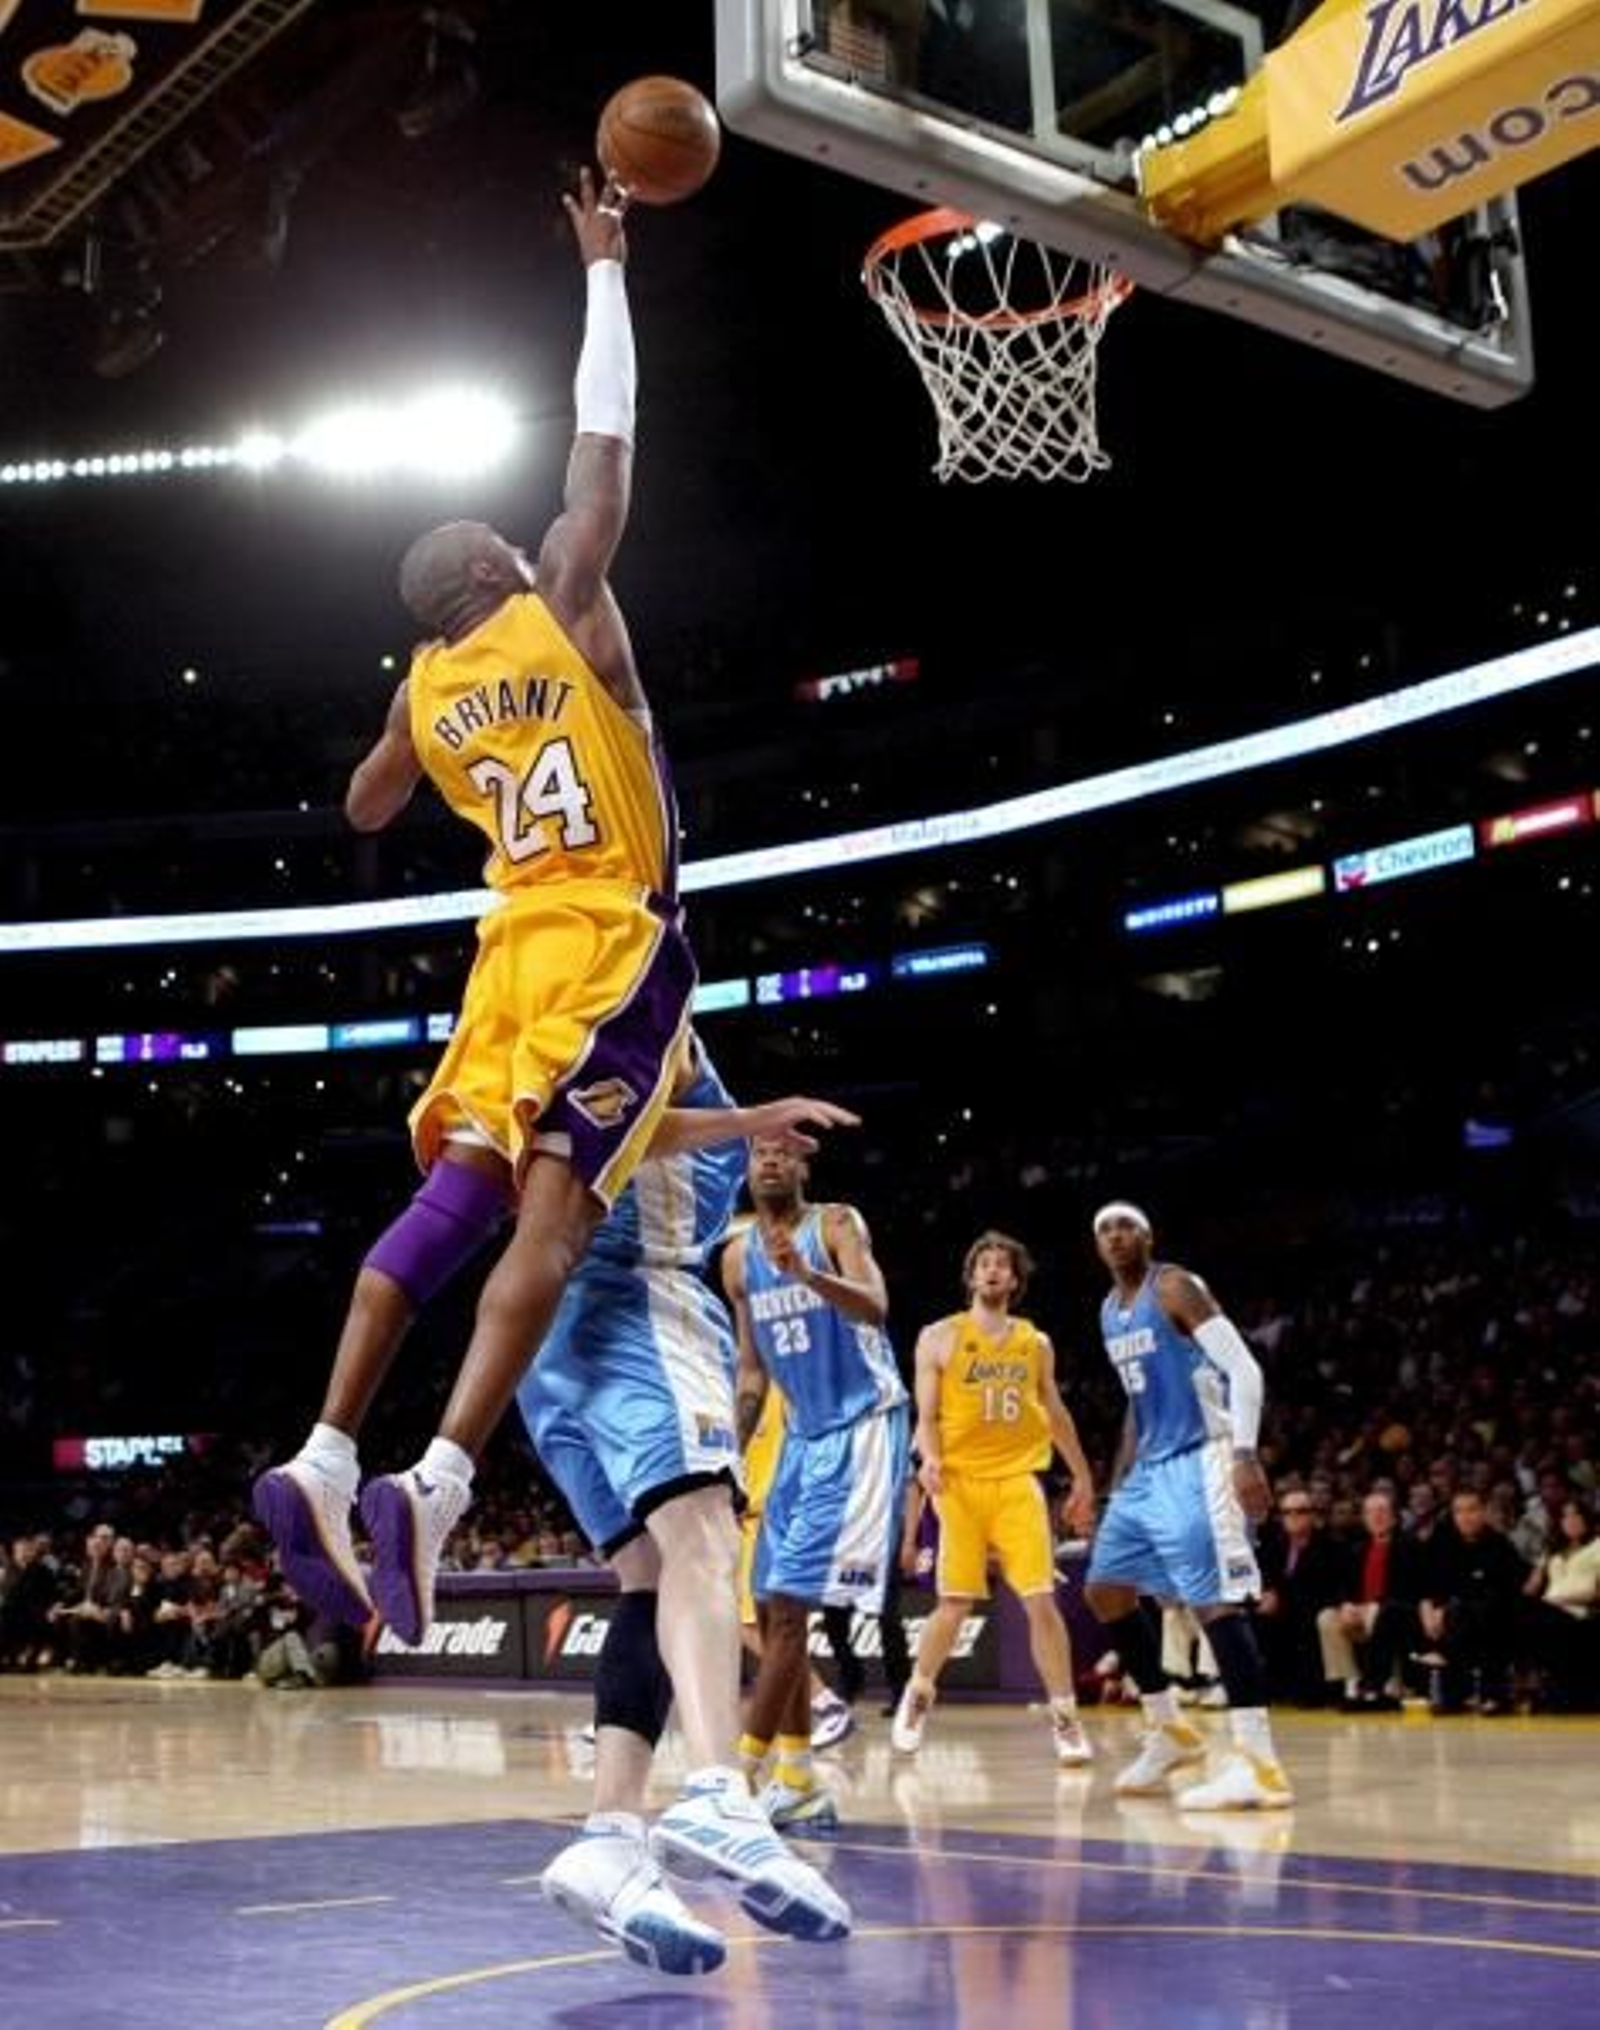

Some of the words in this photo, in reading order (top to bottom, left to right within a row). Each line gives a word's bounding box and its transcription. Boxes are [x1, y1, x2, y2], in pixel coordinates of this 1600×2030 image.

[1337, 0, 1516, 122] LAK
[1403, 77, 1600, 188] com
[434, 678, 574, 750] BRYANT
[464, 735, 600, 866] 24
[1375, 835, 1474, 873] Chevron
[772, 1318, 811, 1357] 23
[983, 1386, 1021, 1421] 16
